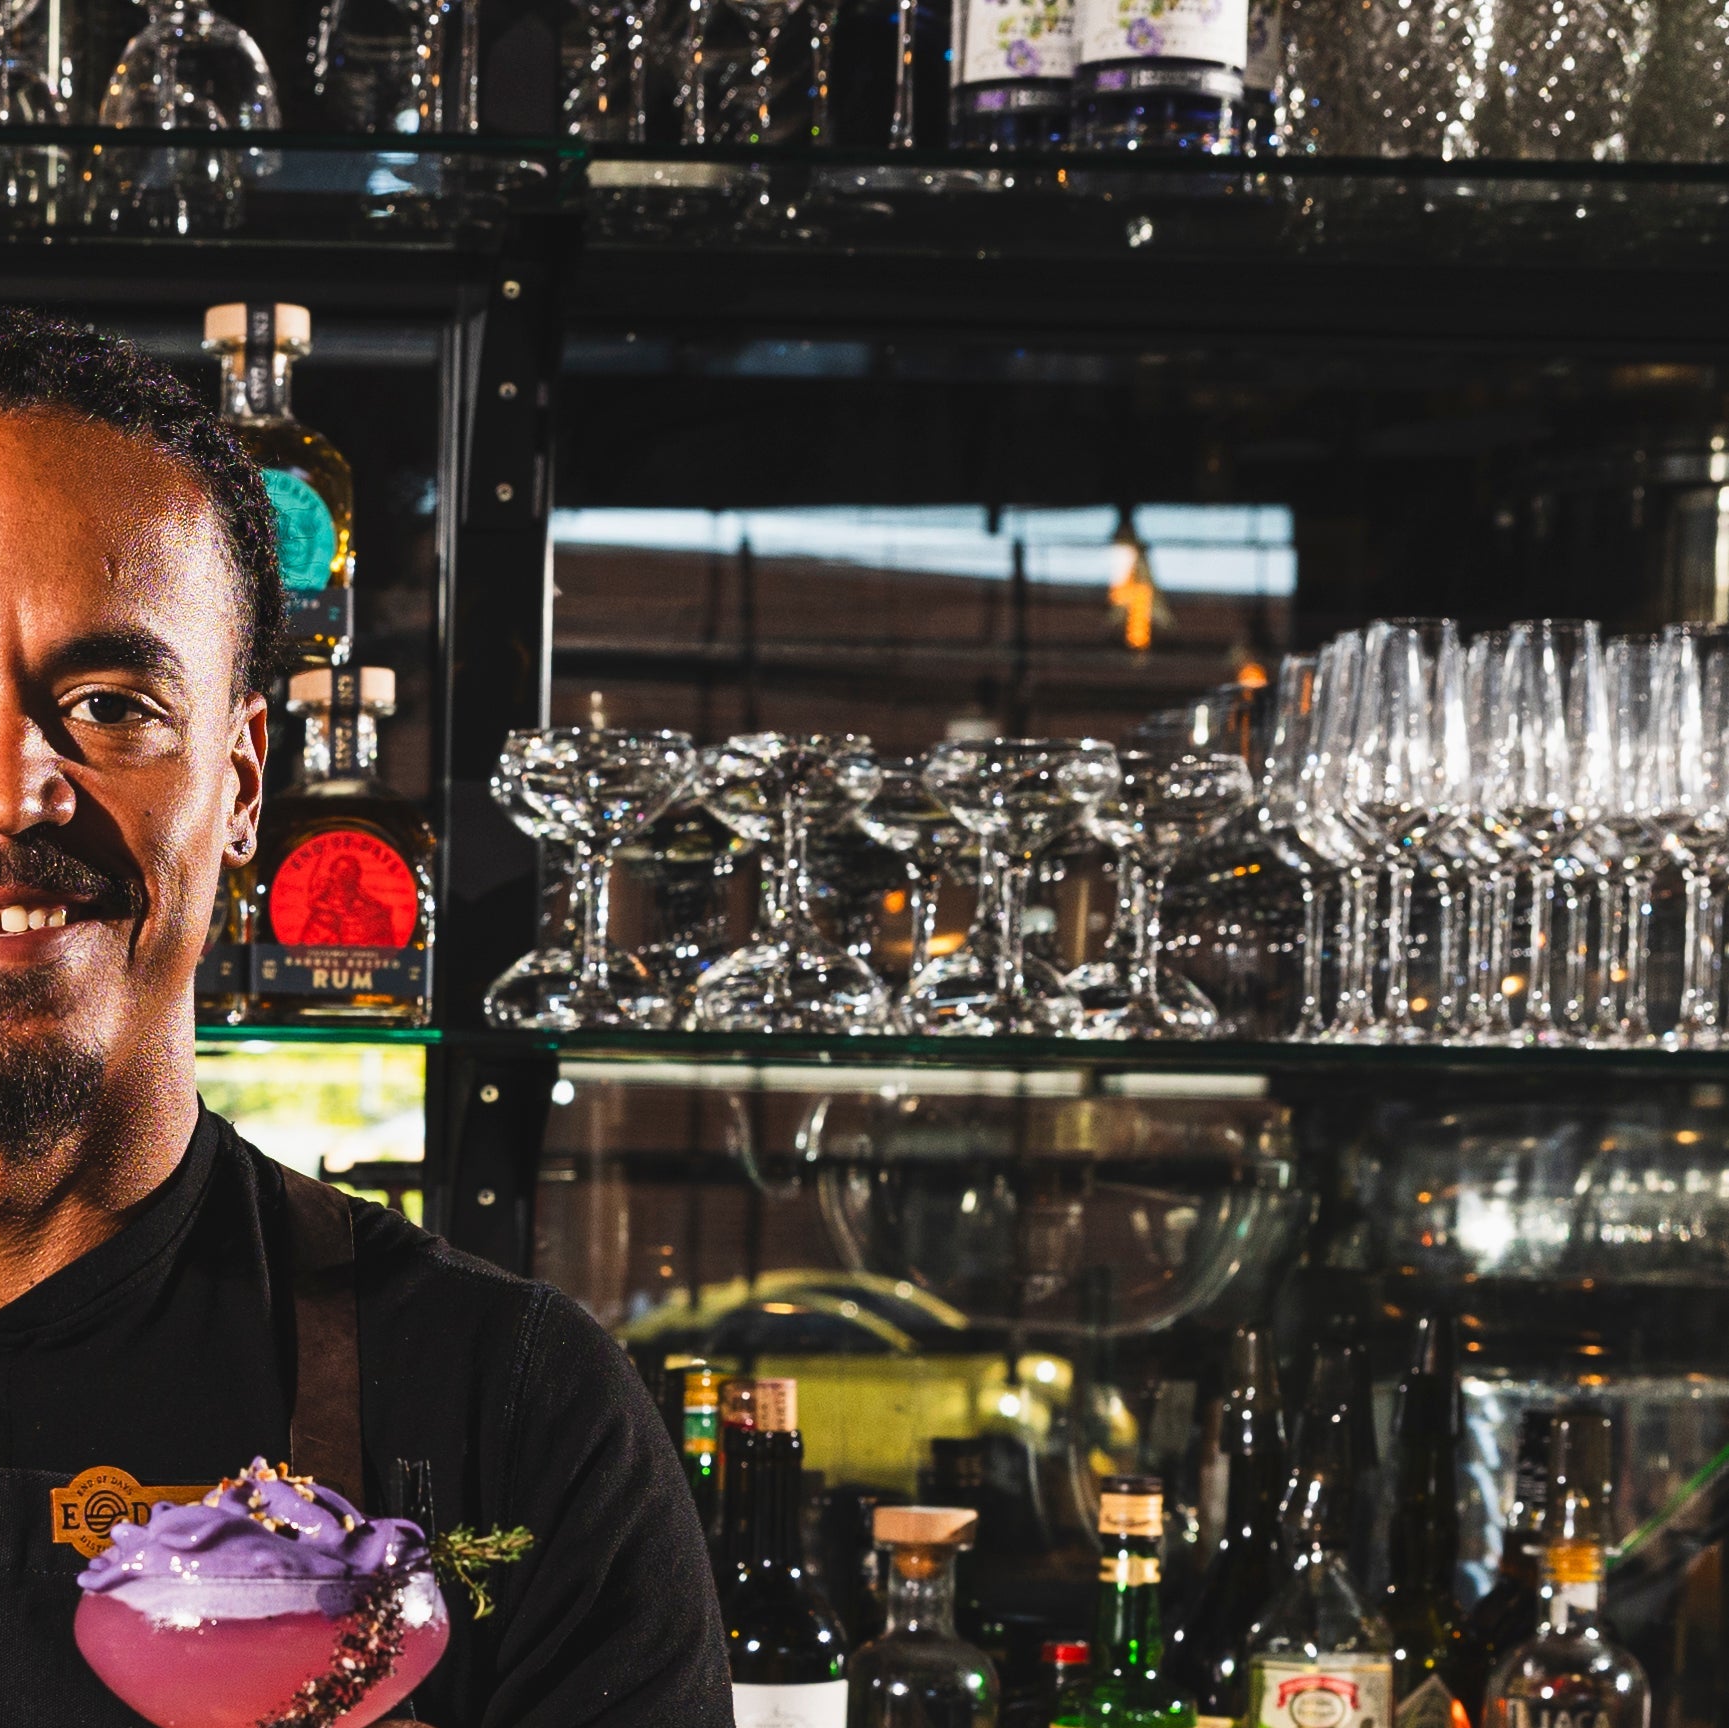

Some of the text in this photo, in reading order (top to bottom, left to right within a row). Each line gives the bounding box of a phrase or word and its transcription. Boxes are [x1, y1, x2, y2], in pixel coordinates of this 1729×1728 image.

[312, 967, 374, 990] RUM
[76, 1475, 134, 1498] END OF DAYS
